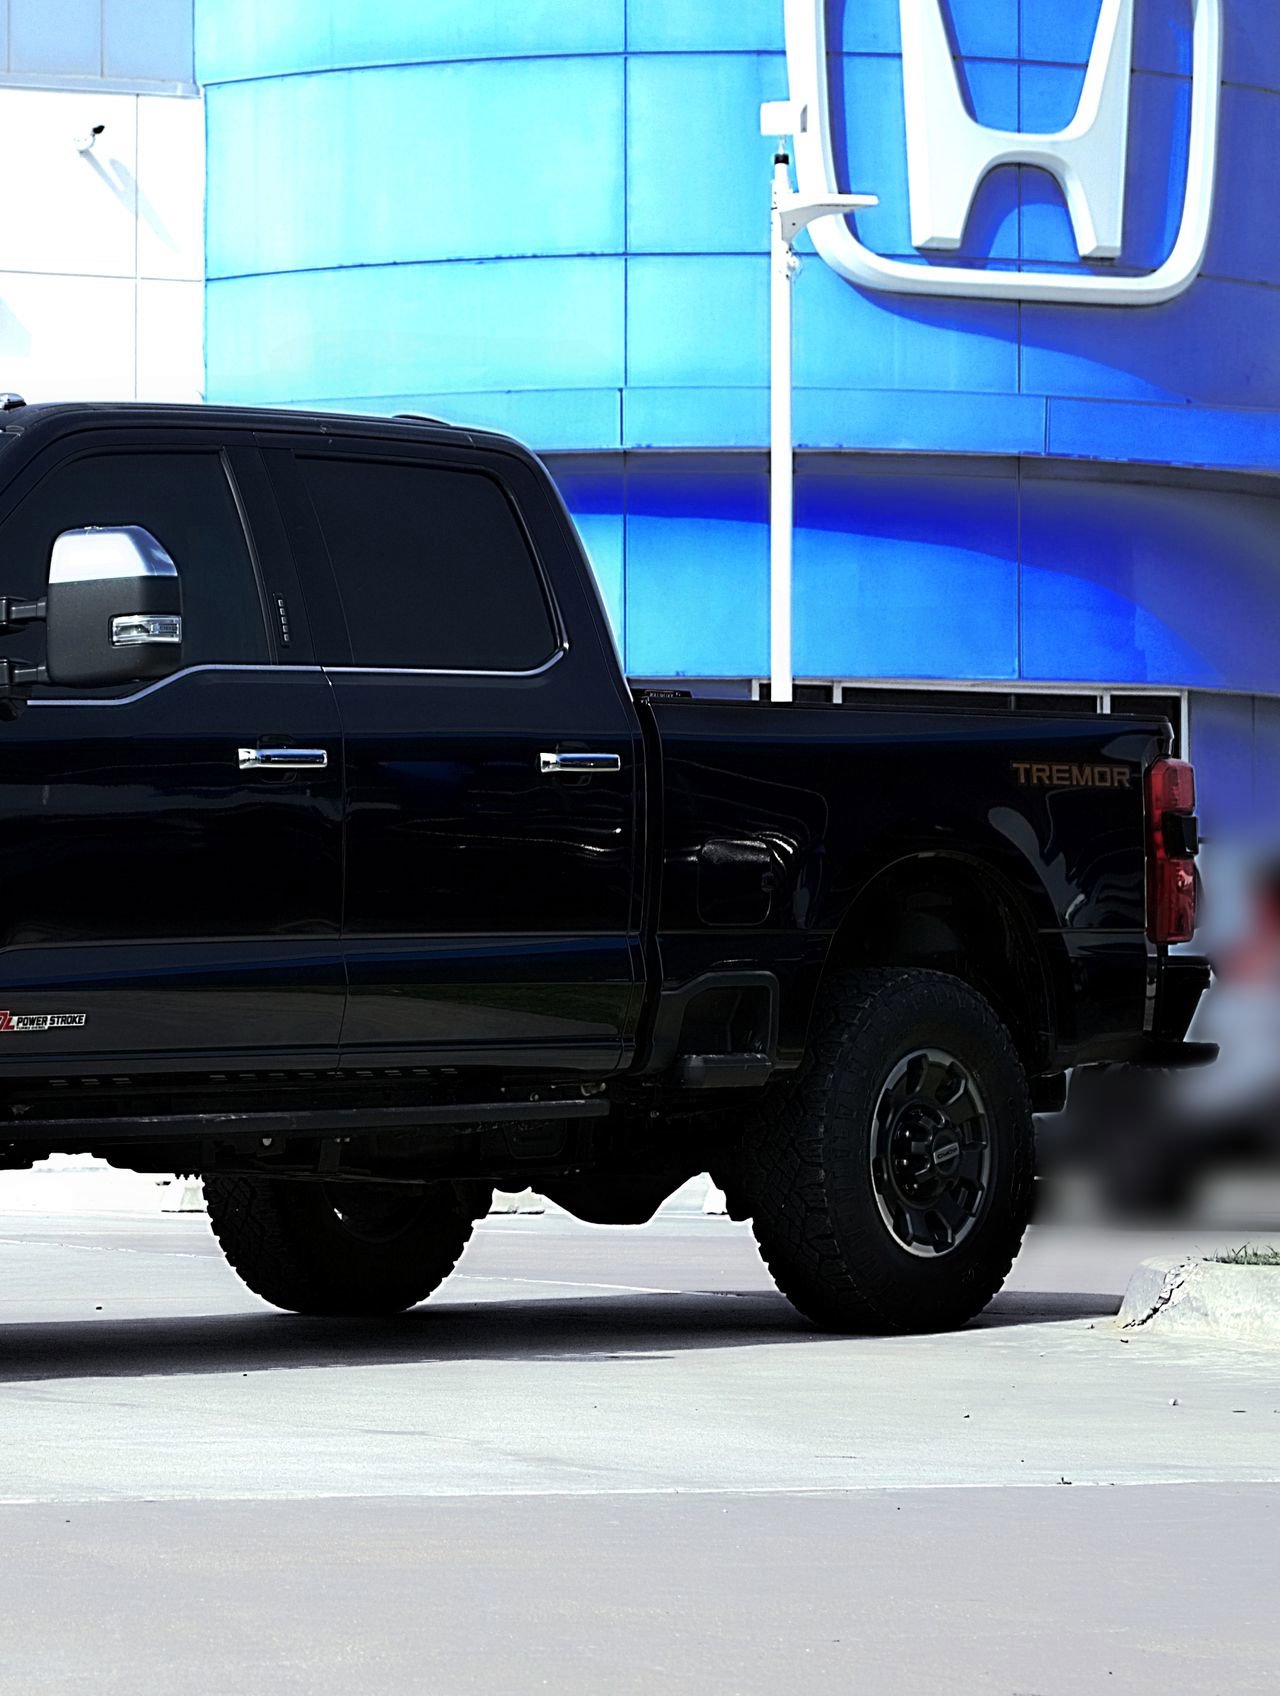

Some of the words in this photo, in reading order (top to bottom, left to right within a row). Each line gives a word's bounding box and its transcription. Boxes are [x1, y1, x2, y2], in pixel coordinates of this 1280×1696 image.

[1011, 762, 1131, 788] TREMOR
[16, 1015, 48, 1027] POWER
[49, 1014, 85, 1026] STROKE
